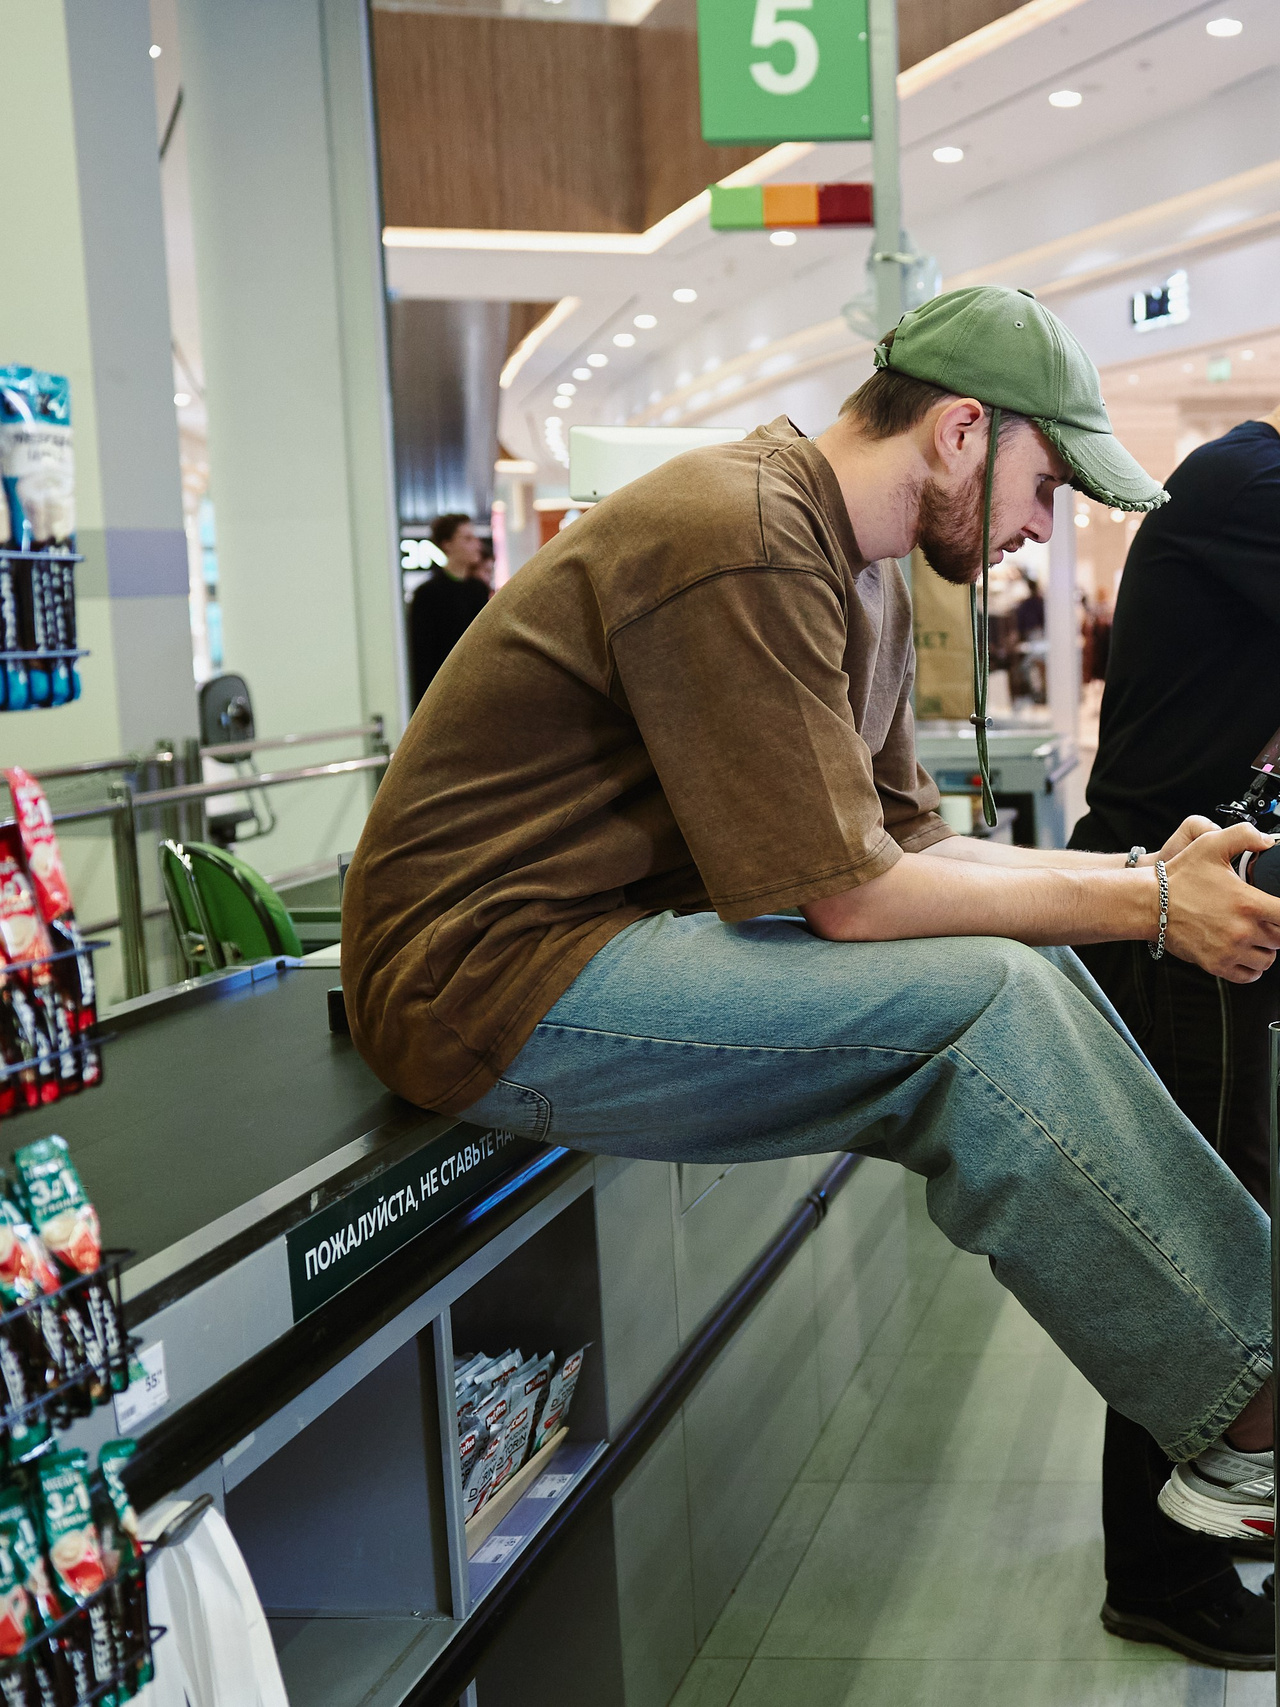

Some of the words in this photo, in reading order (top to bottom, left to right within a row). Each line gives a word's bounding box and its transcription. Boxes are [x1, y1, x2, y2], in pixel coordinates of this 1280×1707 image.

[749, 0, 820, 95] 5
[304, 1185, 420, 1281] ПОЖАЛУЙСТА,
[419, 1167, 439, 1201] НЕ
[440, 1135, 494, 1187] СТАВЬТЕ
